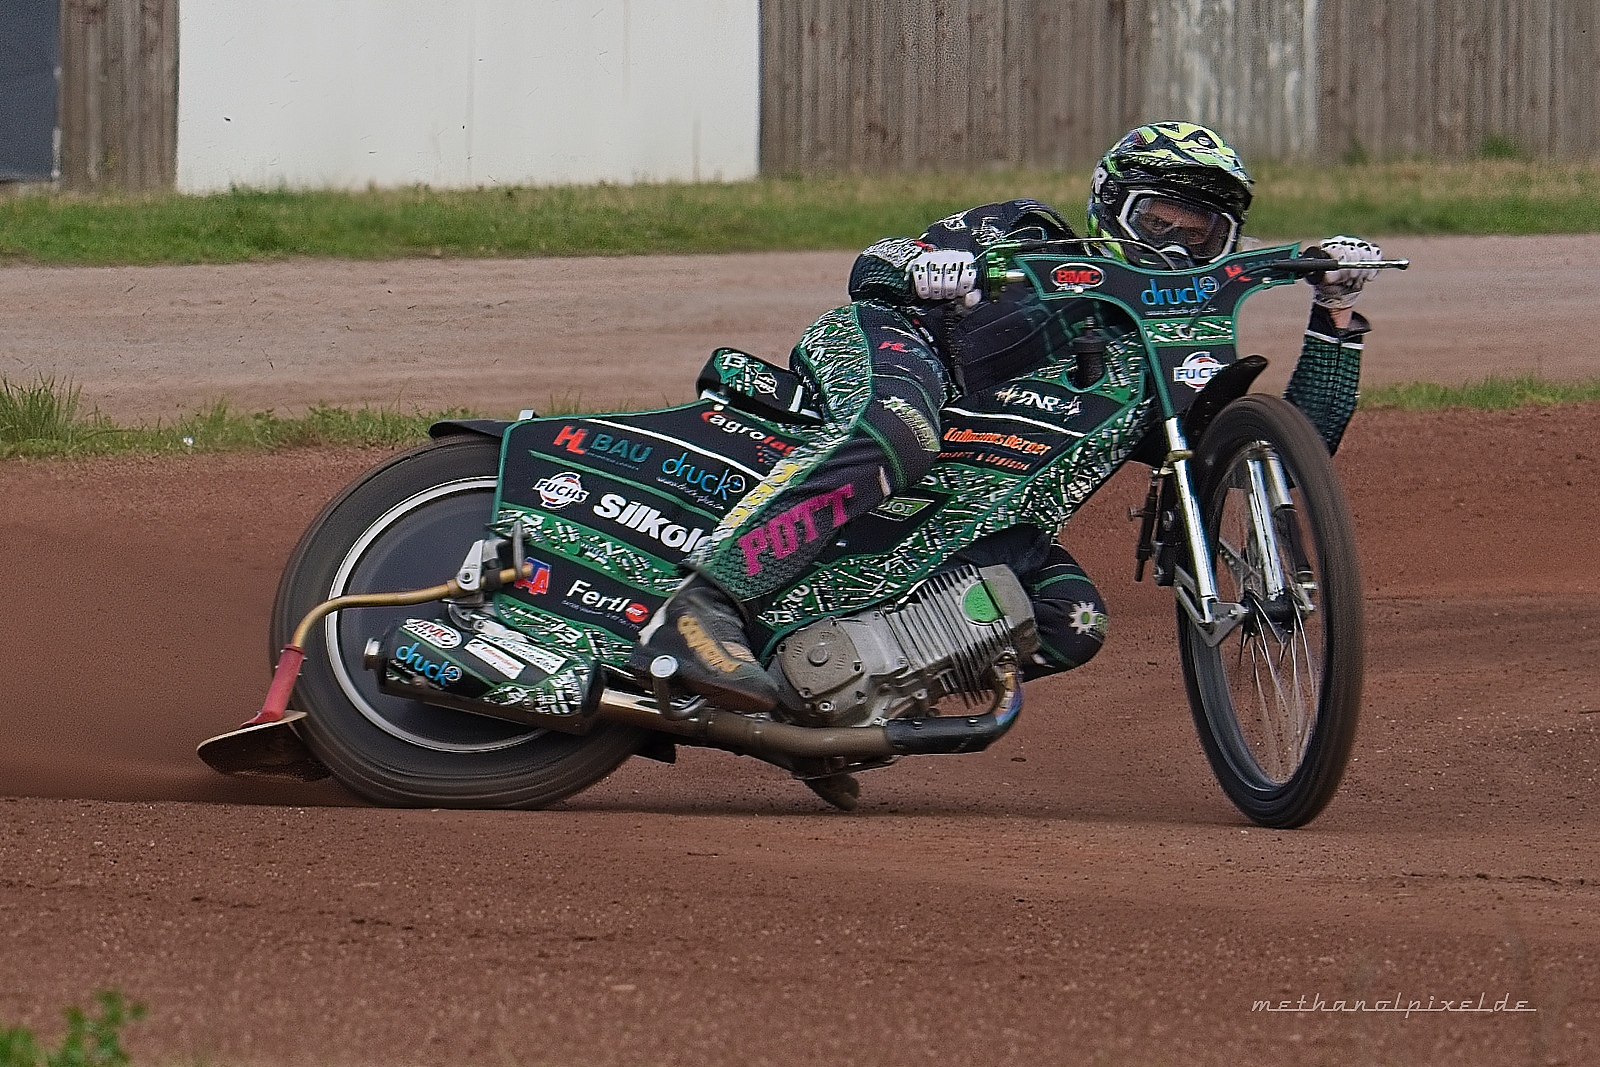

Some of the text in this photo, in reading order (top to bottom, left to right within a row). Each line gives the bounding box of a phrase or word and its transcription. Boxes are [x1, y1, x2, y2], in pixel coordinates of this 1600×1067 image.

[1055, 270, 1101, 283] BMC
[591, 434, 653, 463] BAU
[536, 480, 588, 503] FUCHS
[593, 493, 704, 553] Silkol
[736, 483, 855, 577] POTT
[566, 579, 632, 613] Fertl
